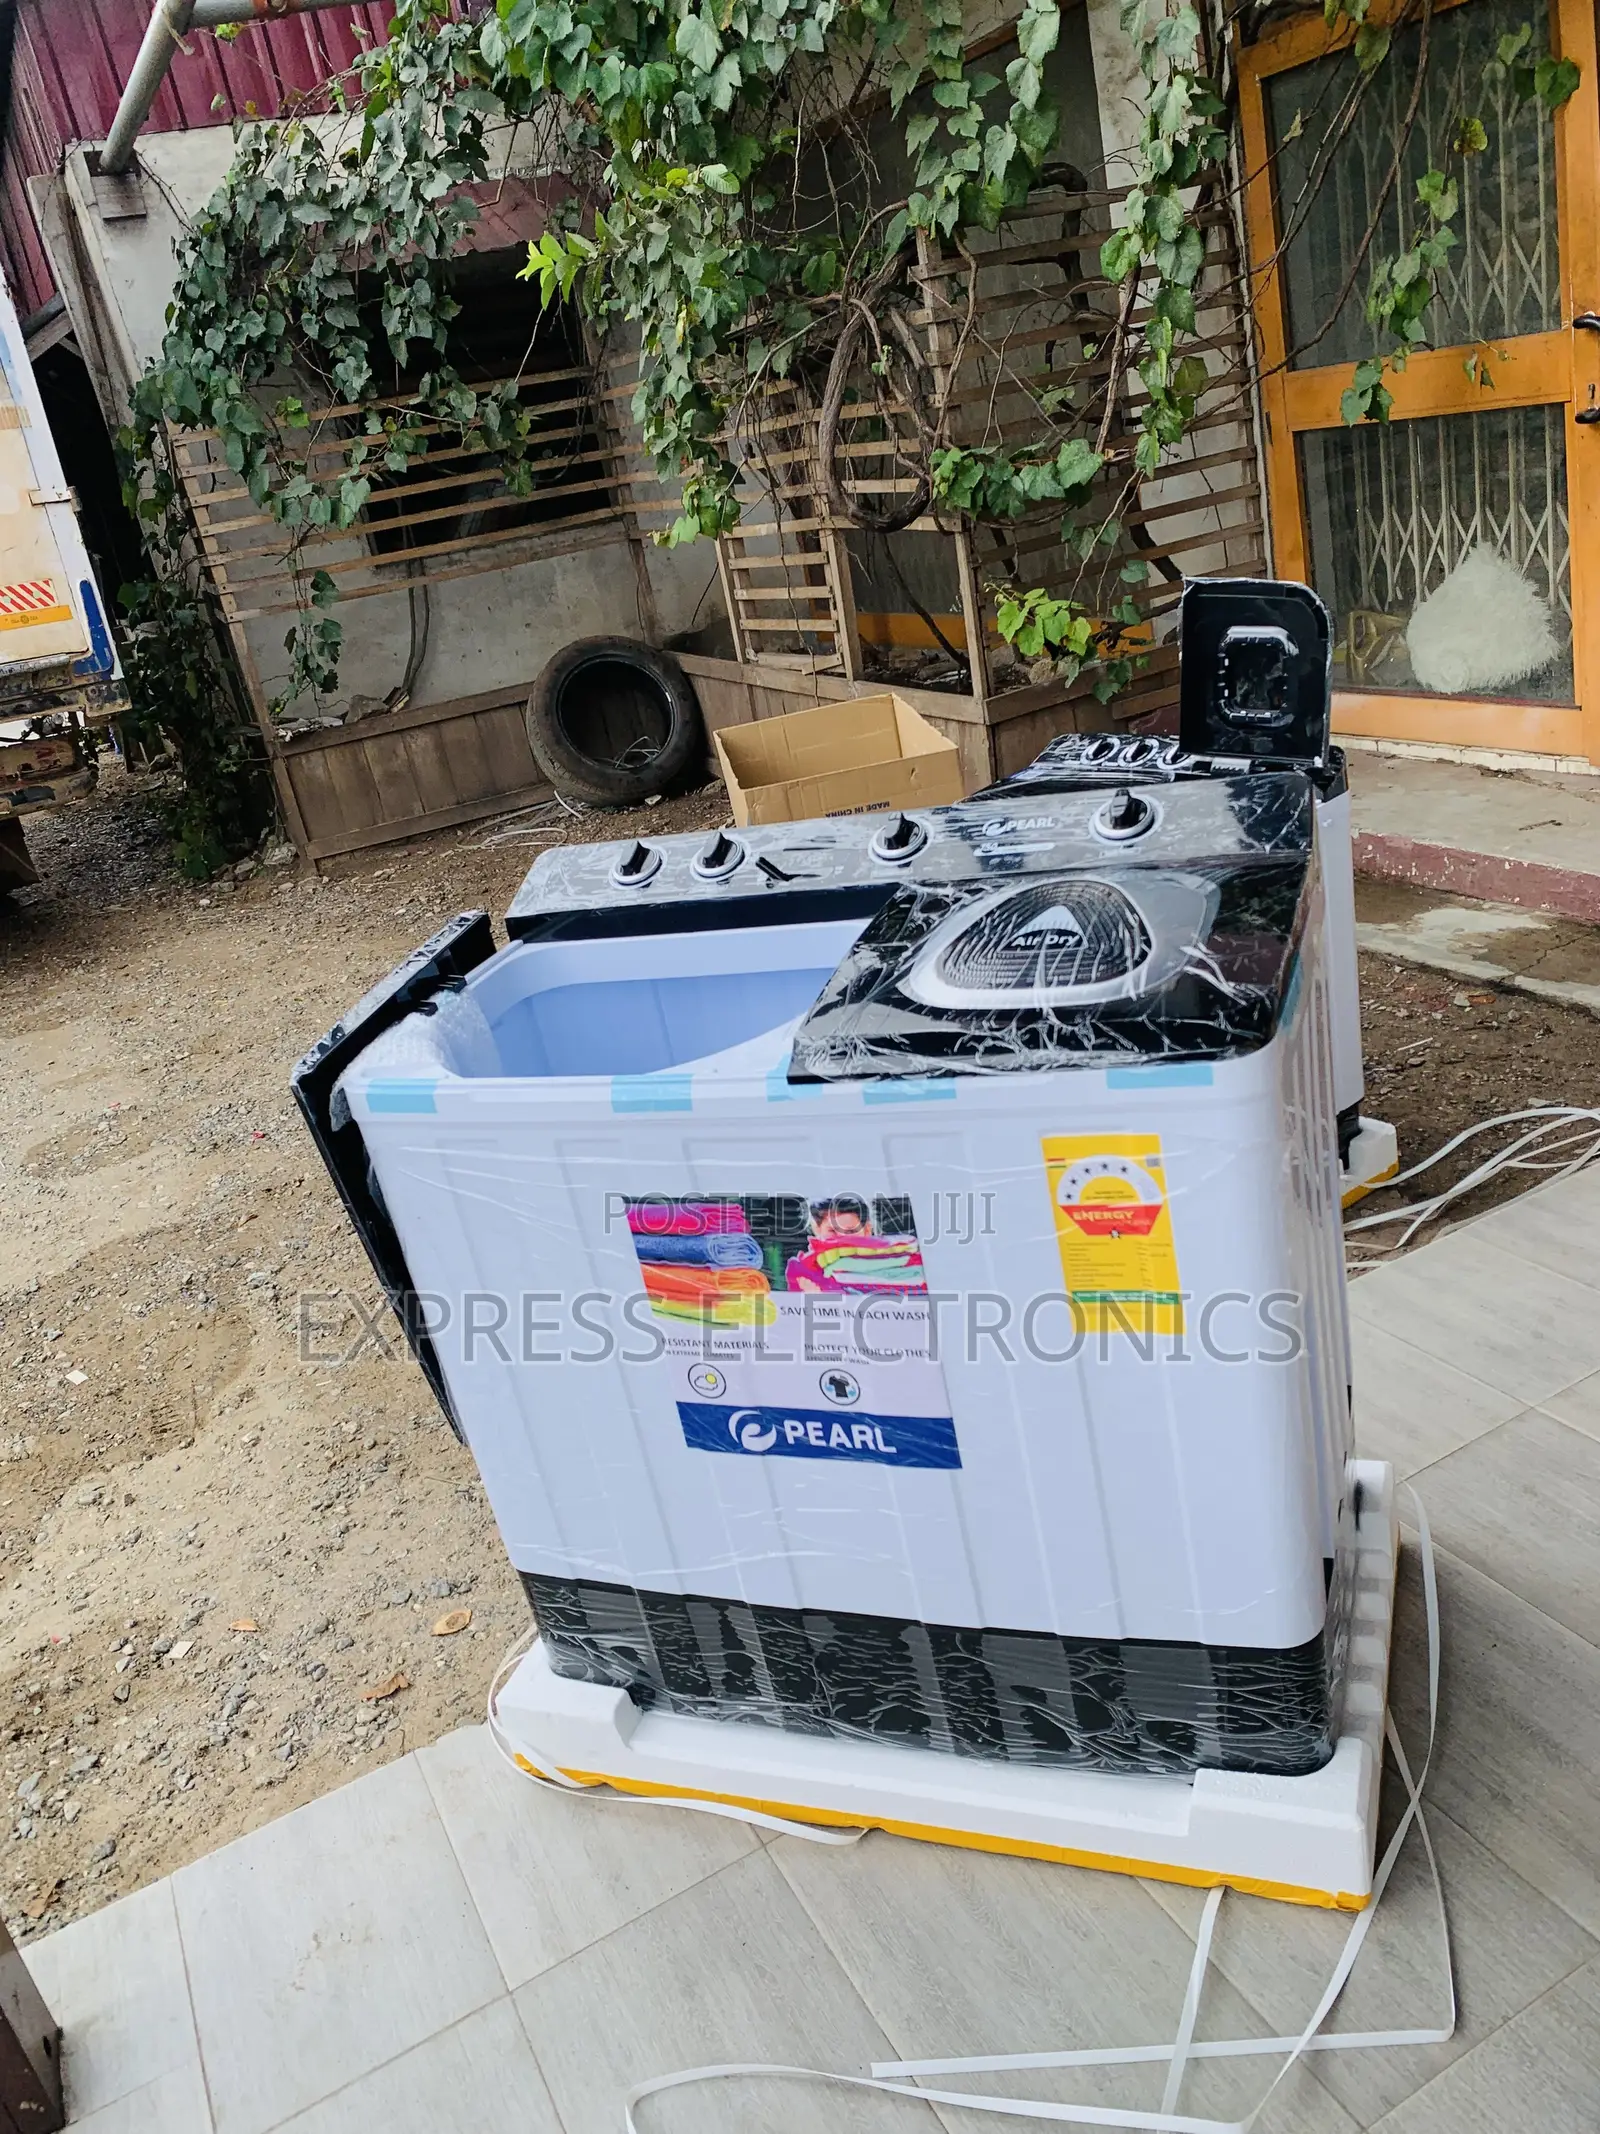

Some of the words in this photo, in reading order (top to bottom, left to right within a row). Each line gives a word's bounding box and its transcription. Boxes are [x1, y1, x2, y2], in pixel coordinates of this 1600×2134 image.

[854, 806, 864, 815] IN
[866, 801, 890, 812] MADE
[825, 809, 853, 818] CHINA
[1006, 816, 1056, 831] PEARL
[1072, 1209, 1135, 1222] ENERGY
[780, 1306, 809, 1317] SAVE
[813, 1307, 840, 1317] TIME
[844, 1309, 855, 1319] IN
[859, 1310, 890, 1321] EACH
[892, 1311, 931, 1321] WASH
[661, 1337, 712, 1348] RESISTANT
[714, 1341, 770, 1350] MATERIALS
[804, 1343, 849, 1354] PROTECT
[851, 1345, 881, 1357] YOUR
[884, 1348, 932, 1358] CLOTHES
[783, 1418, 898, 1454] PEARL
